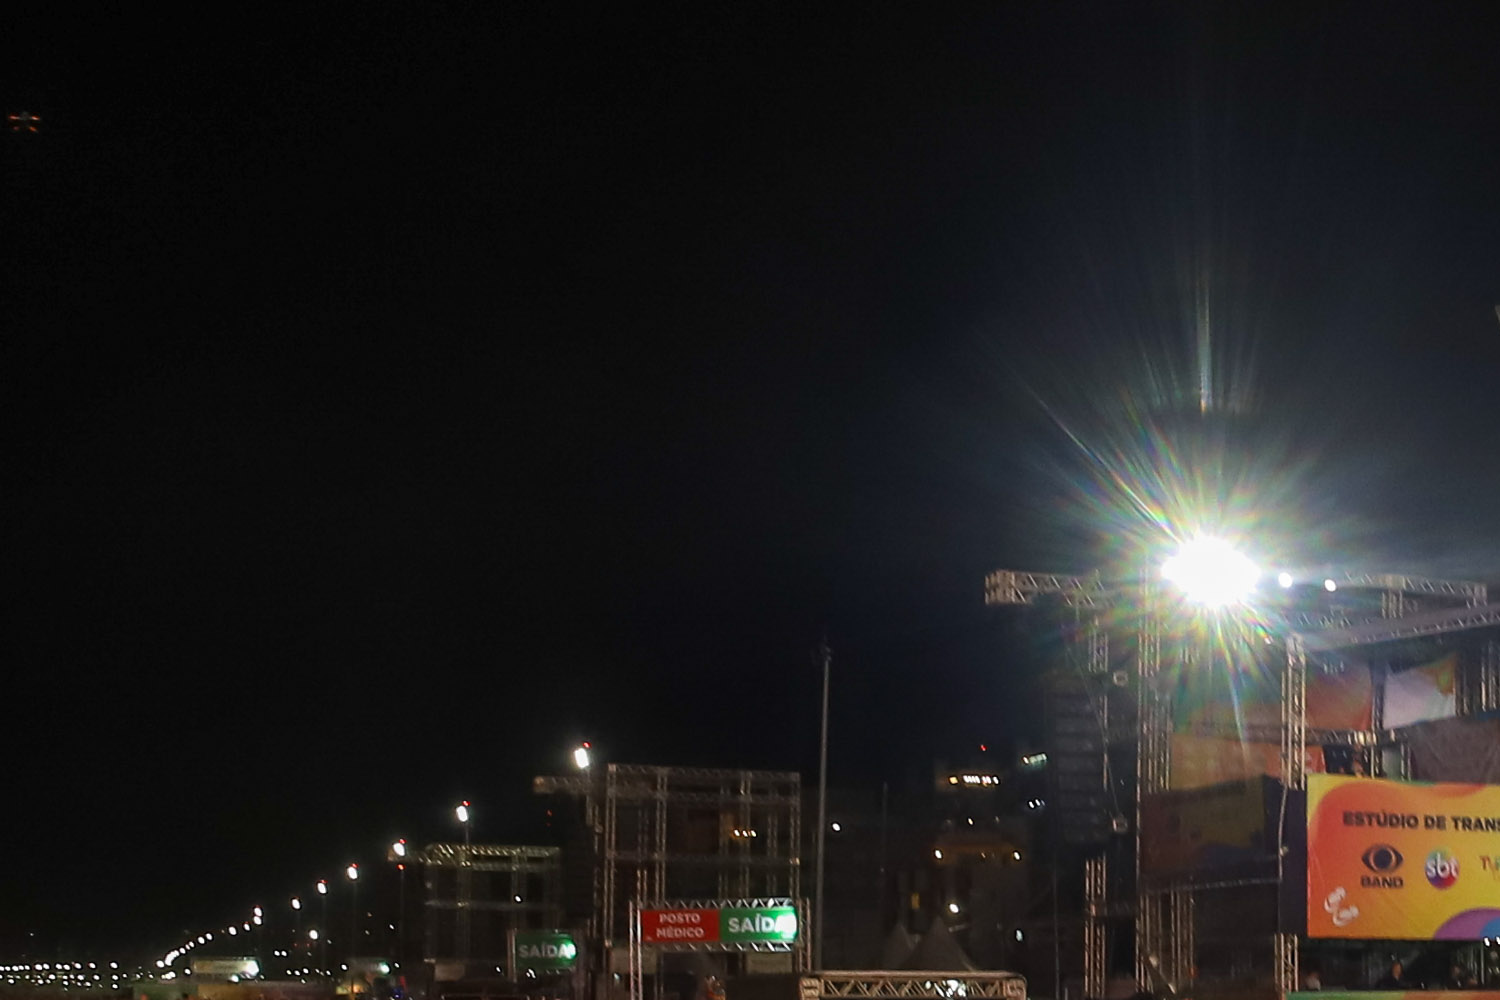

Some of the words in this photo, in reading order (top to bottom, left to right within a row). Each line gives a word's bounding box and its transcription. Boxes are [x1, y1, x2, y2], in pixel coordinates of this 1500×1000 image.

[1343, 809, 1419, 829] ESTÚDIO
[1424, 815, 1447, 830] DE
[1361, 876, 1403, 888] BAND
[659, 912, 701, 925] POSTO
[656, 925, 704, 939] MÉDICO
